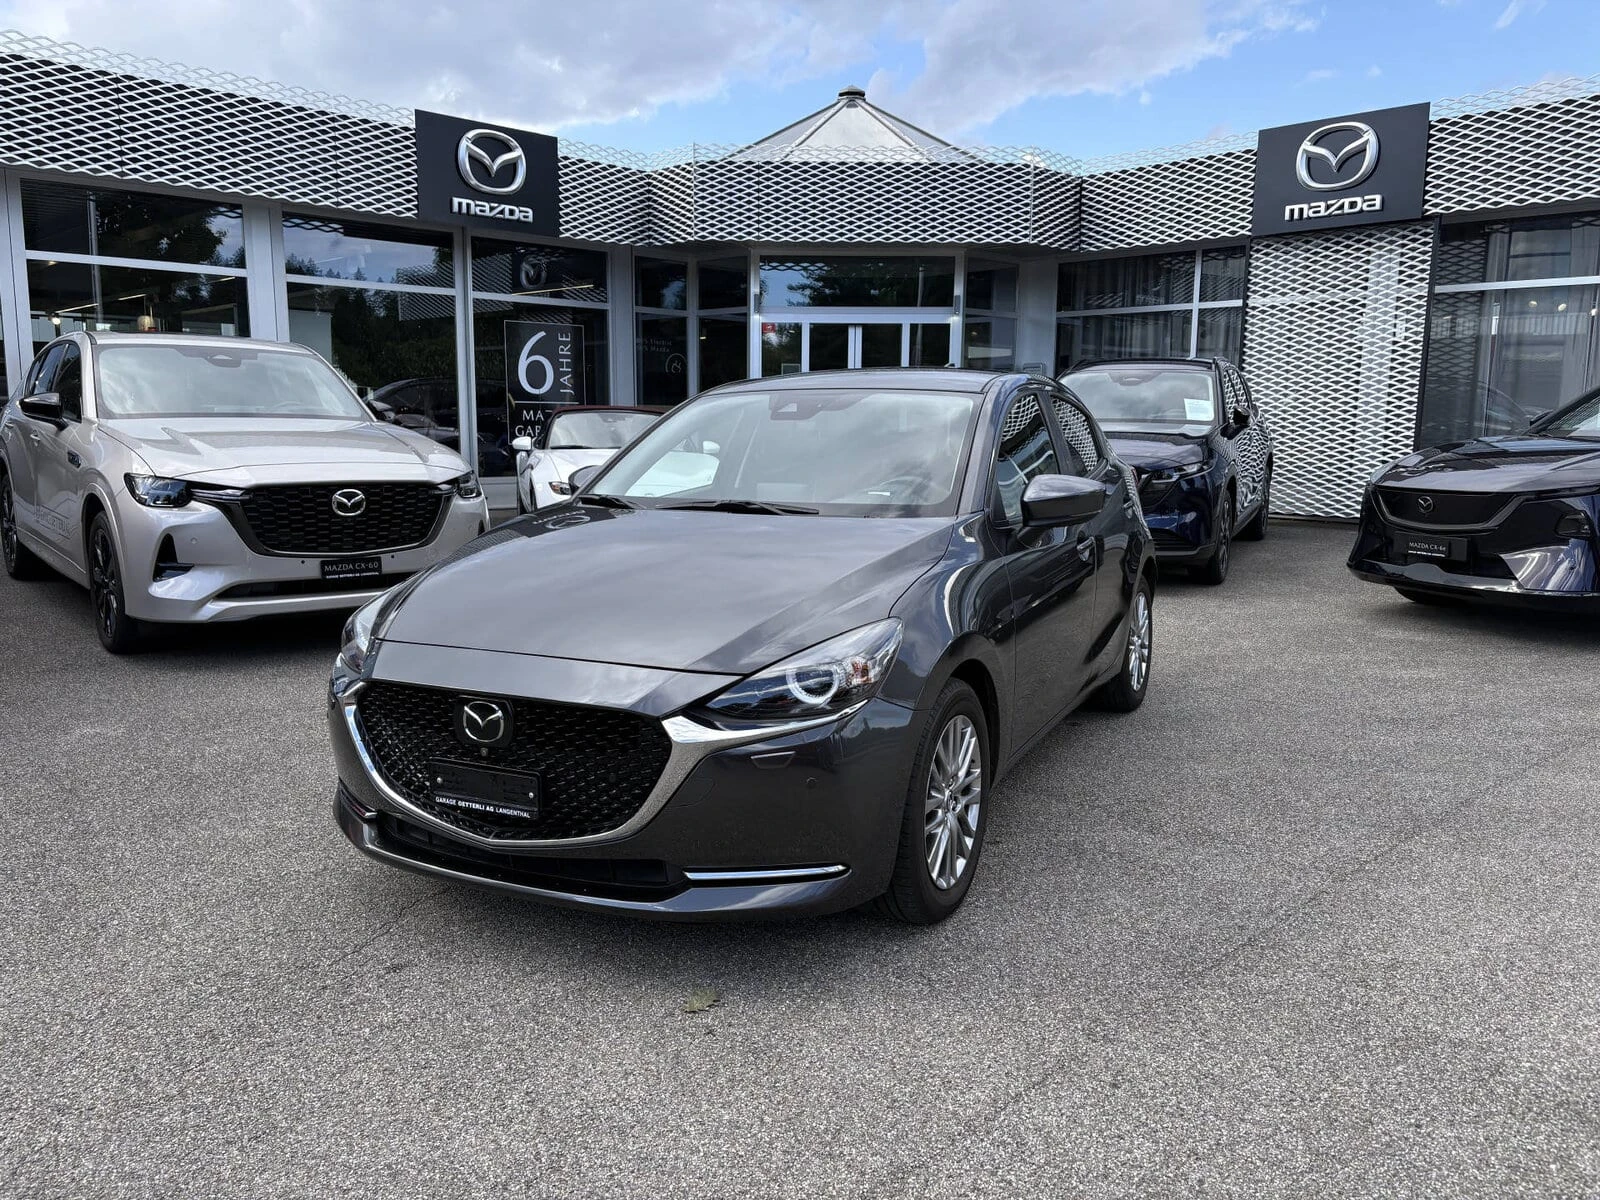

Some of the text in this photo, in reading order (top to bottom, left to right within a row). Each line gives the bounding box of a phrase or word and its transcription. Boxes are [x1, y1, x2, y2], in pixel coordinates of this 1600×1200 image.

[517, 330, 575, 396] 6 JAHRE
[522, 409, 552, 421] MA
[1409, 541, 1429, 550] MAZDA
[324, 561, 379, 572] MAZDA CX-60
[435, 796, 457, 806] GARAGE
[486, 804, 494, 813] AG
[495, 806, 531, 818] LANGENTHAL
